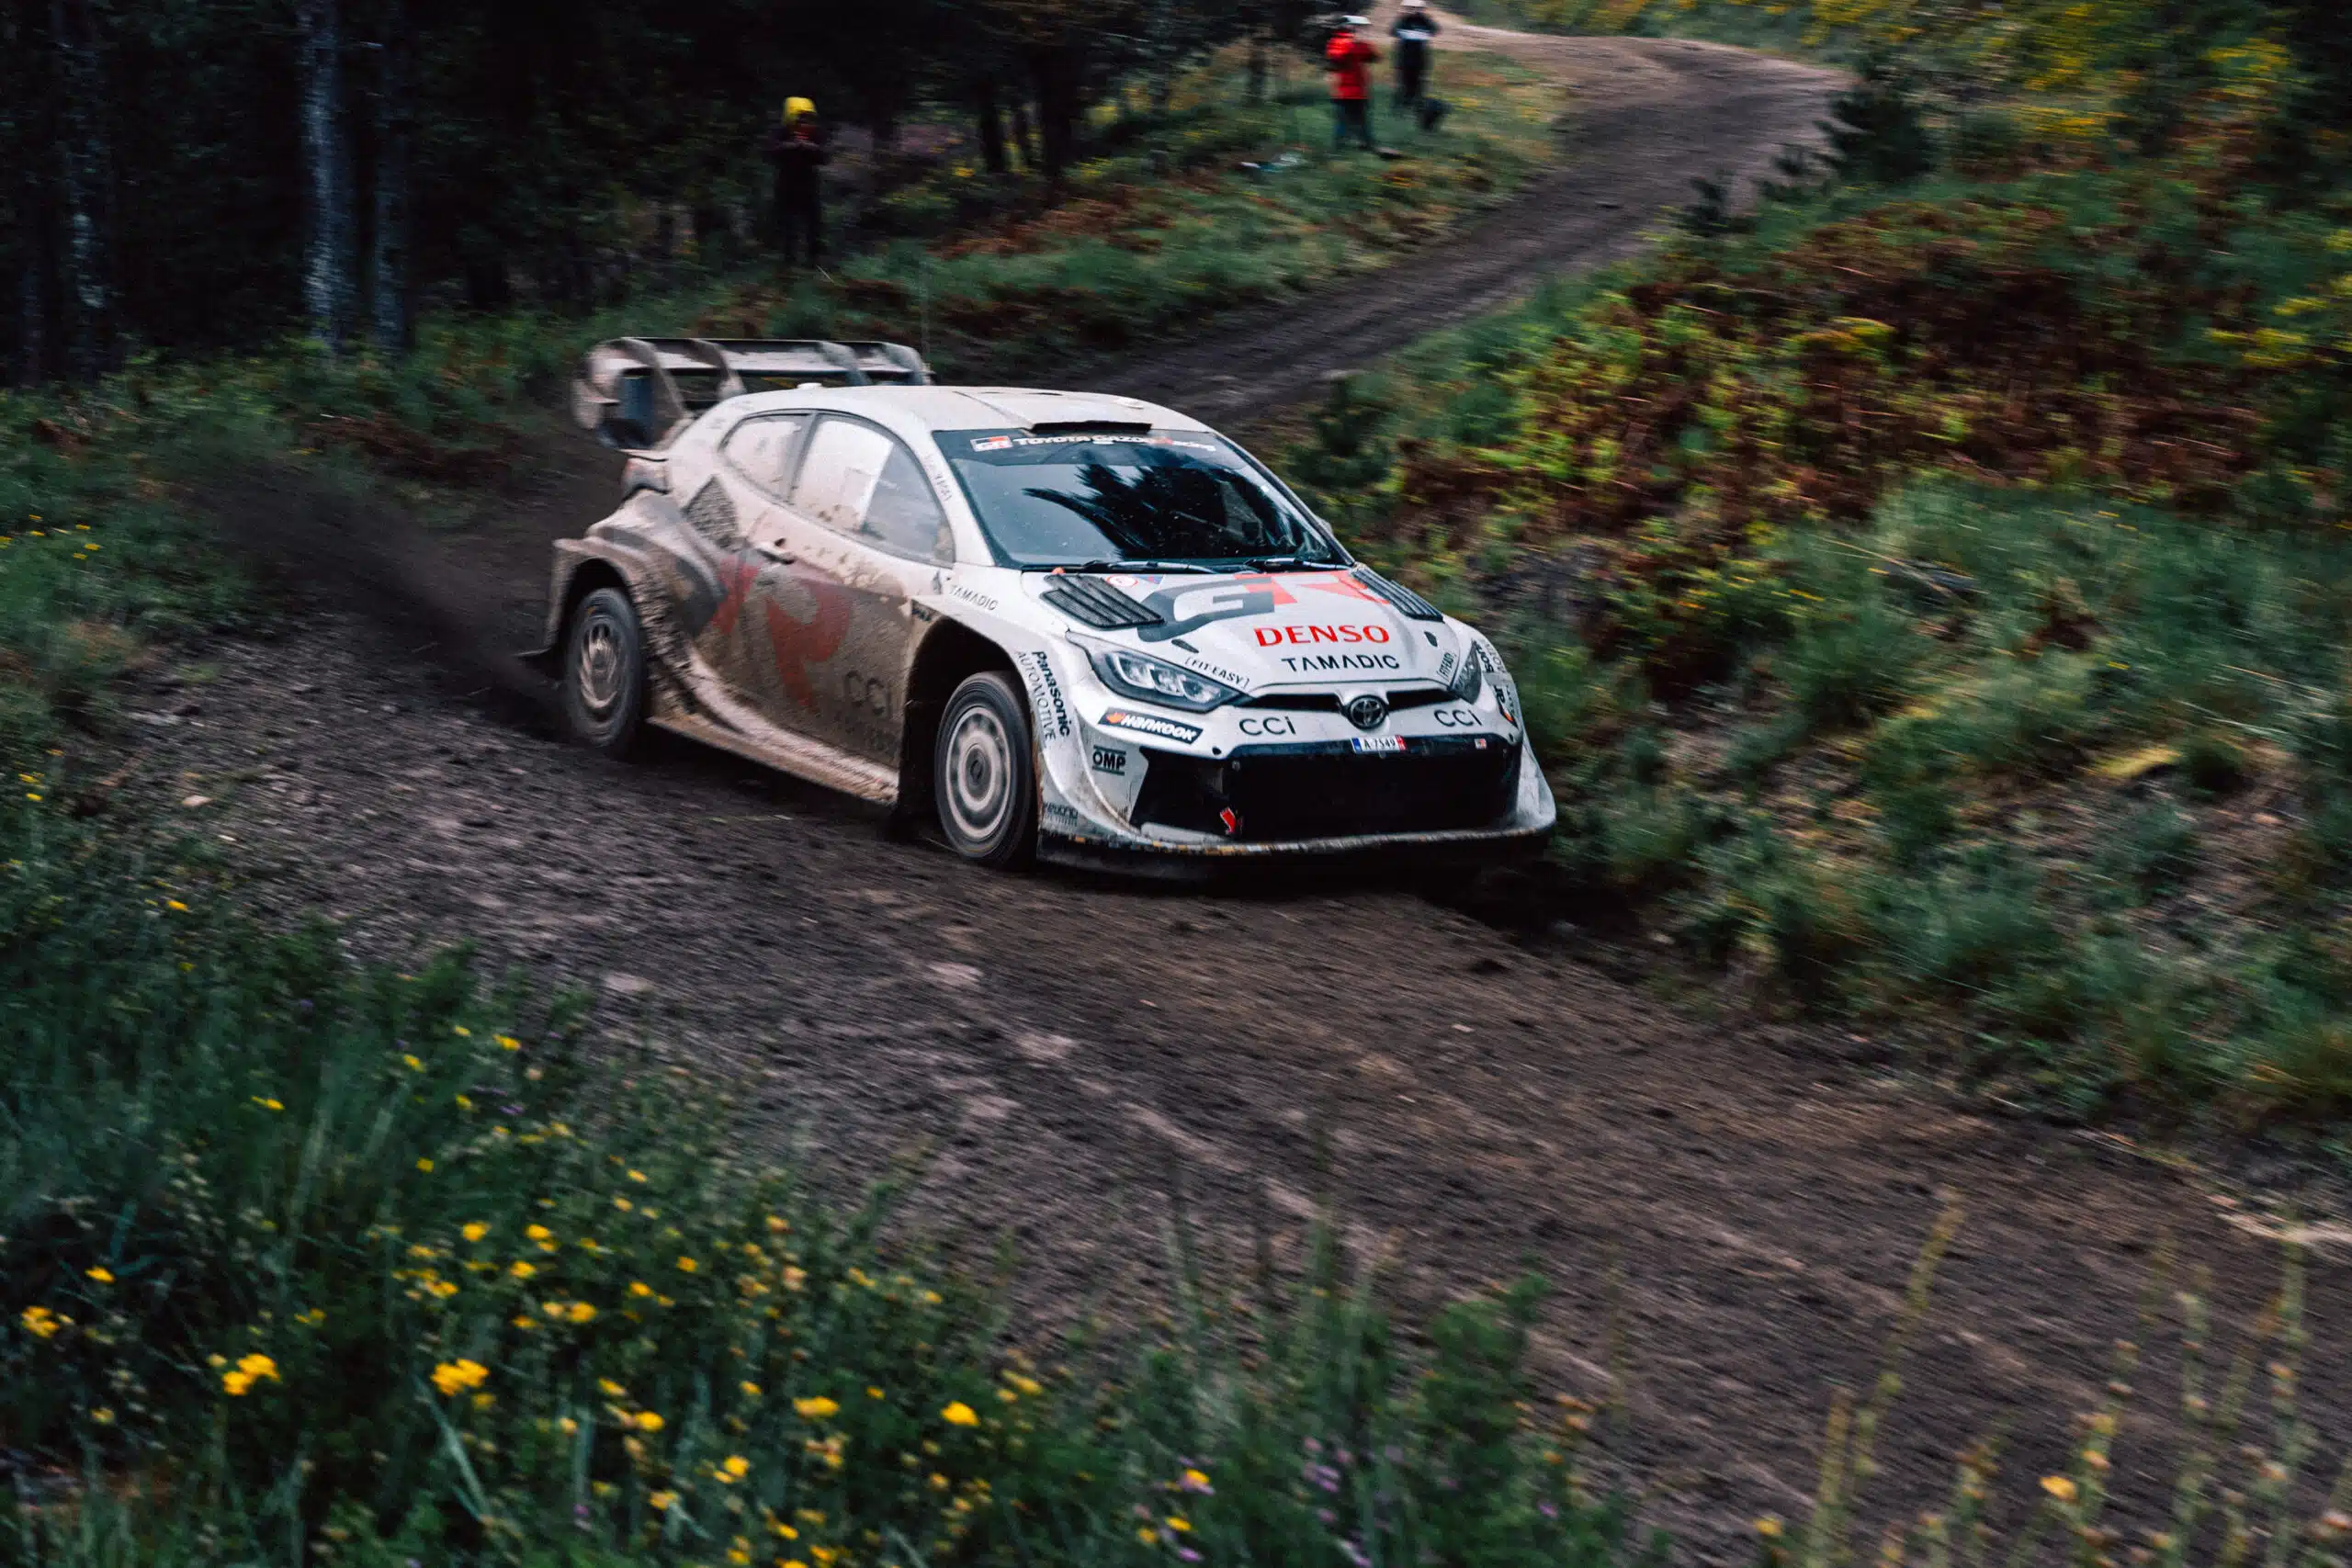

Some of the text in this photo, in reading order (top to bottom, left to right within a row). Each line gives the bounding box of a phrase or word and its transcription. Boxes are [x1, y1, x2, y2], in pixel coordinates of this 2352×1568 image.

[950, 584, 998, 611] TAMADIC
[1253, 625, 1390, 647] DENSO
[1282, 654, 1400, 672] TAMADIC
[1015, 651, 1057, 740] AUTOMOTIVE
[1032, 651, 1072, 737] Panasonic
[1238, 716, 1296, 736] CCI
[1433, 709, 1483, 728] CCI
[1092, 751, 1125, 770] OMP
